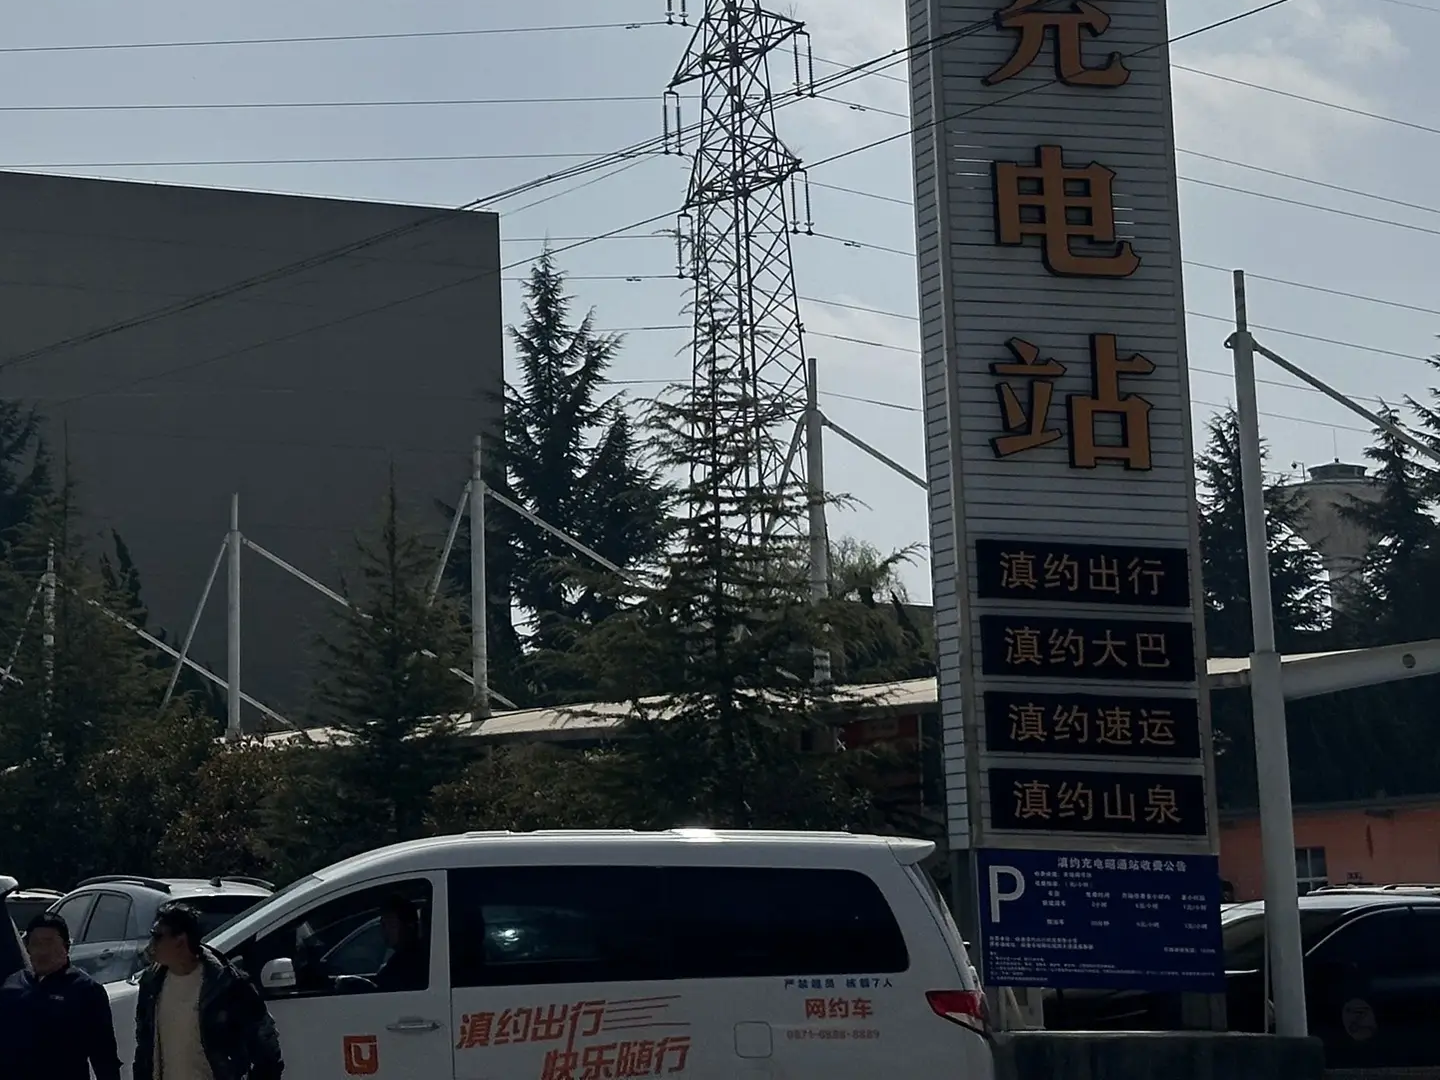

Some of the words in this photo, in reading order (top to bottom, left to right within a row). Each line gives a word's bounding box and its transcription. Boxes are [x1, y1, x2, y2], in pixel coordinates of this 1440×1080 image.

[999, 550, 1166, 597] 滇约出行
[1003, 625, 1171, 669] 滇约大巴
[1007, 701, 1177, 746] 滇约速运
[1012, 779, 1184, 825] 滇约山泉
[988, 865, 1026, 923] P
[456, 1000, 605, 1050] 滇约出行
[804, 997, 874, 1020] 网约车
[539, 1035, 692, 1080] 快乐随行
